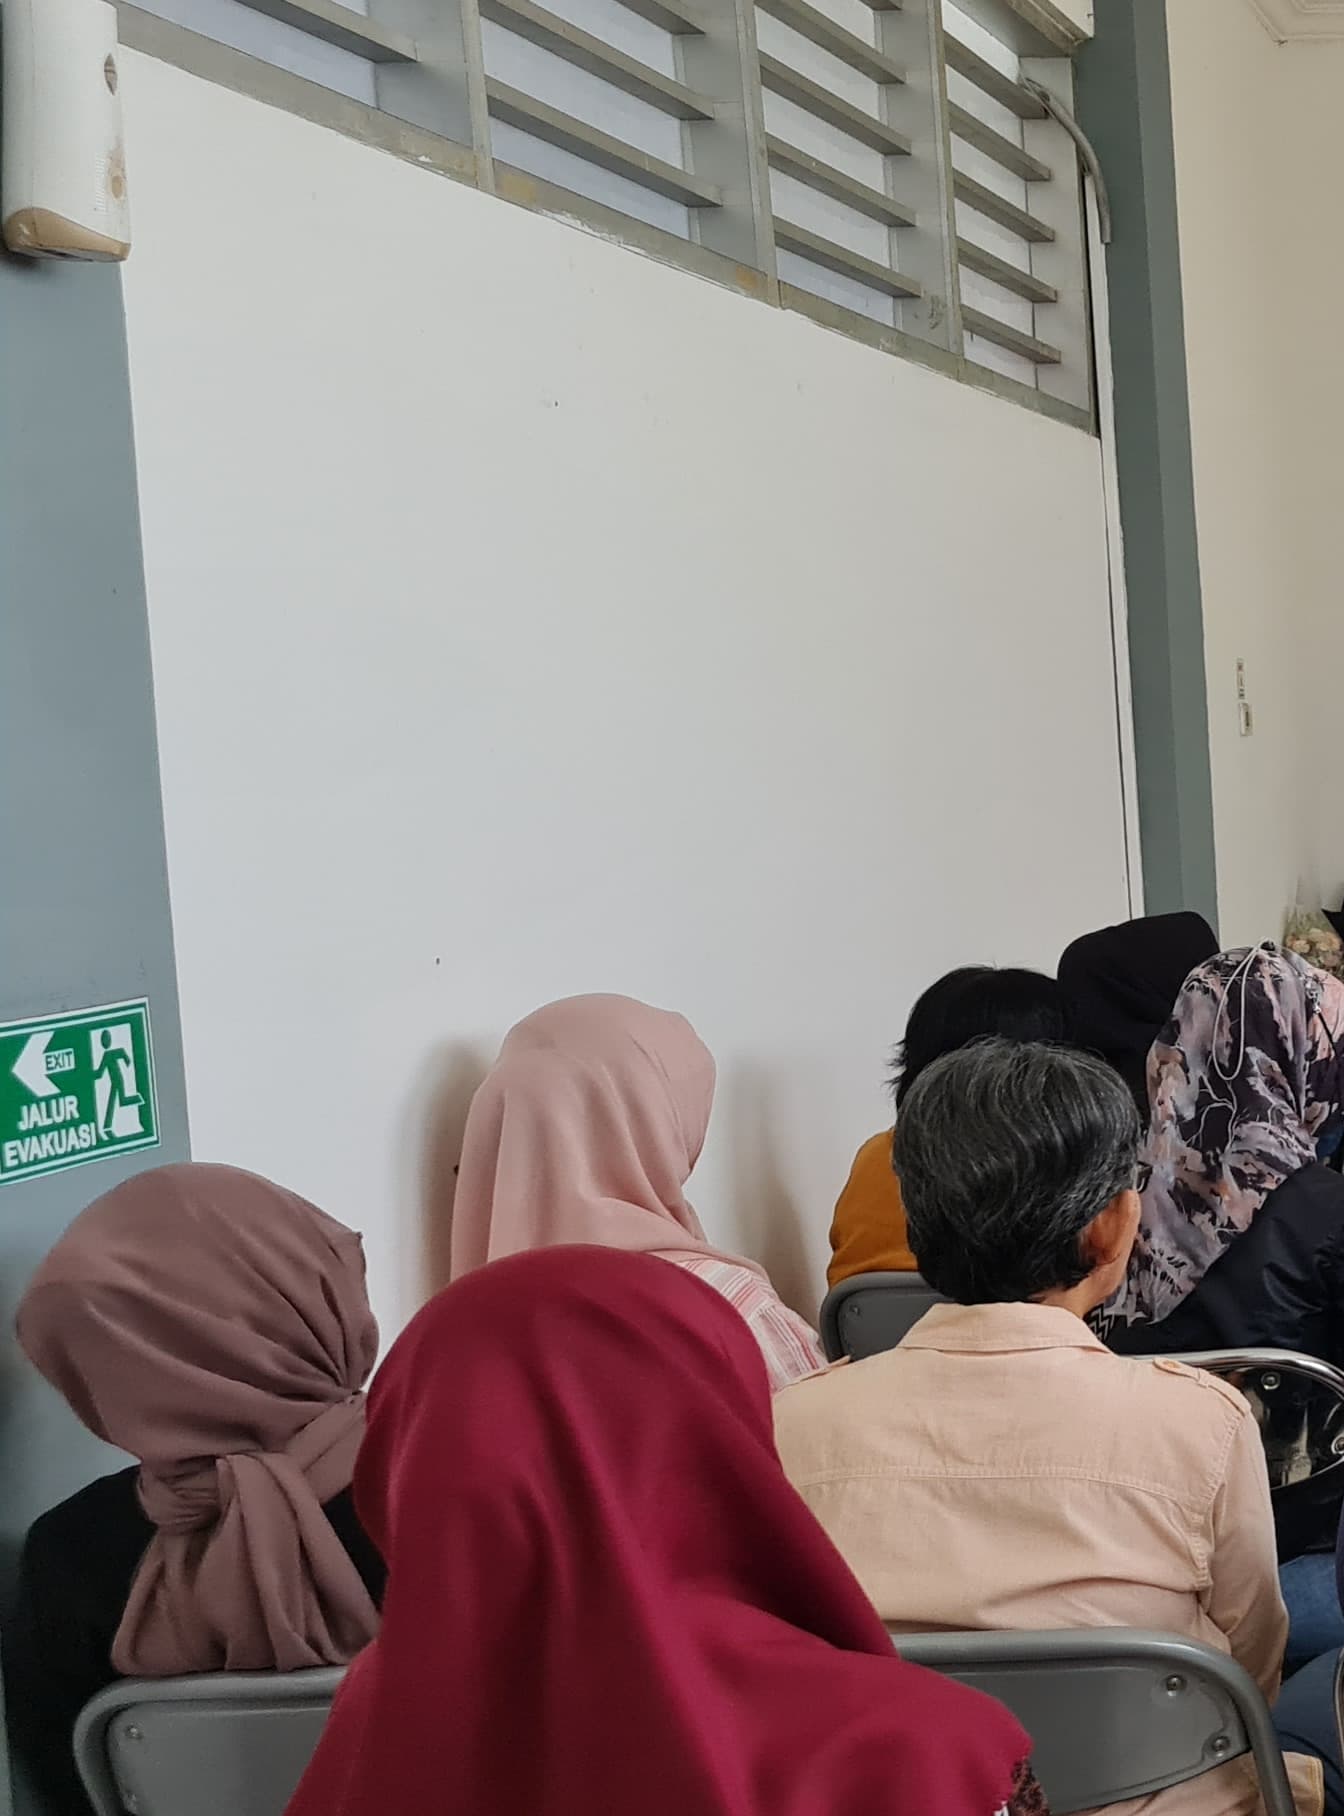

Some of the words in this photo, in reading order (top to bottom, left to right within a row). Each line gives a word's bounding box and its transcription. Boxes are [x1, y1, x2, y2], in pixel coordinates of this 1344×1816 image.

[45, 1051, 73, 1072] EXIT
[17, 1095, 80, 1131] JALUR
[3, 1122, 97, 1168] EVAKUASI
